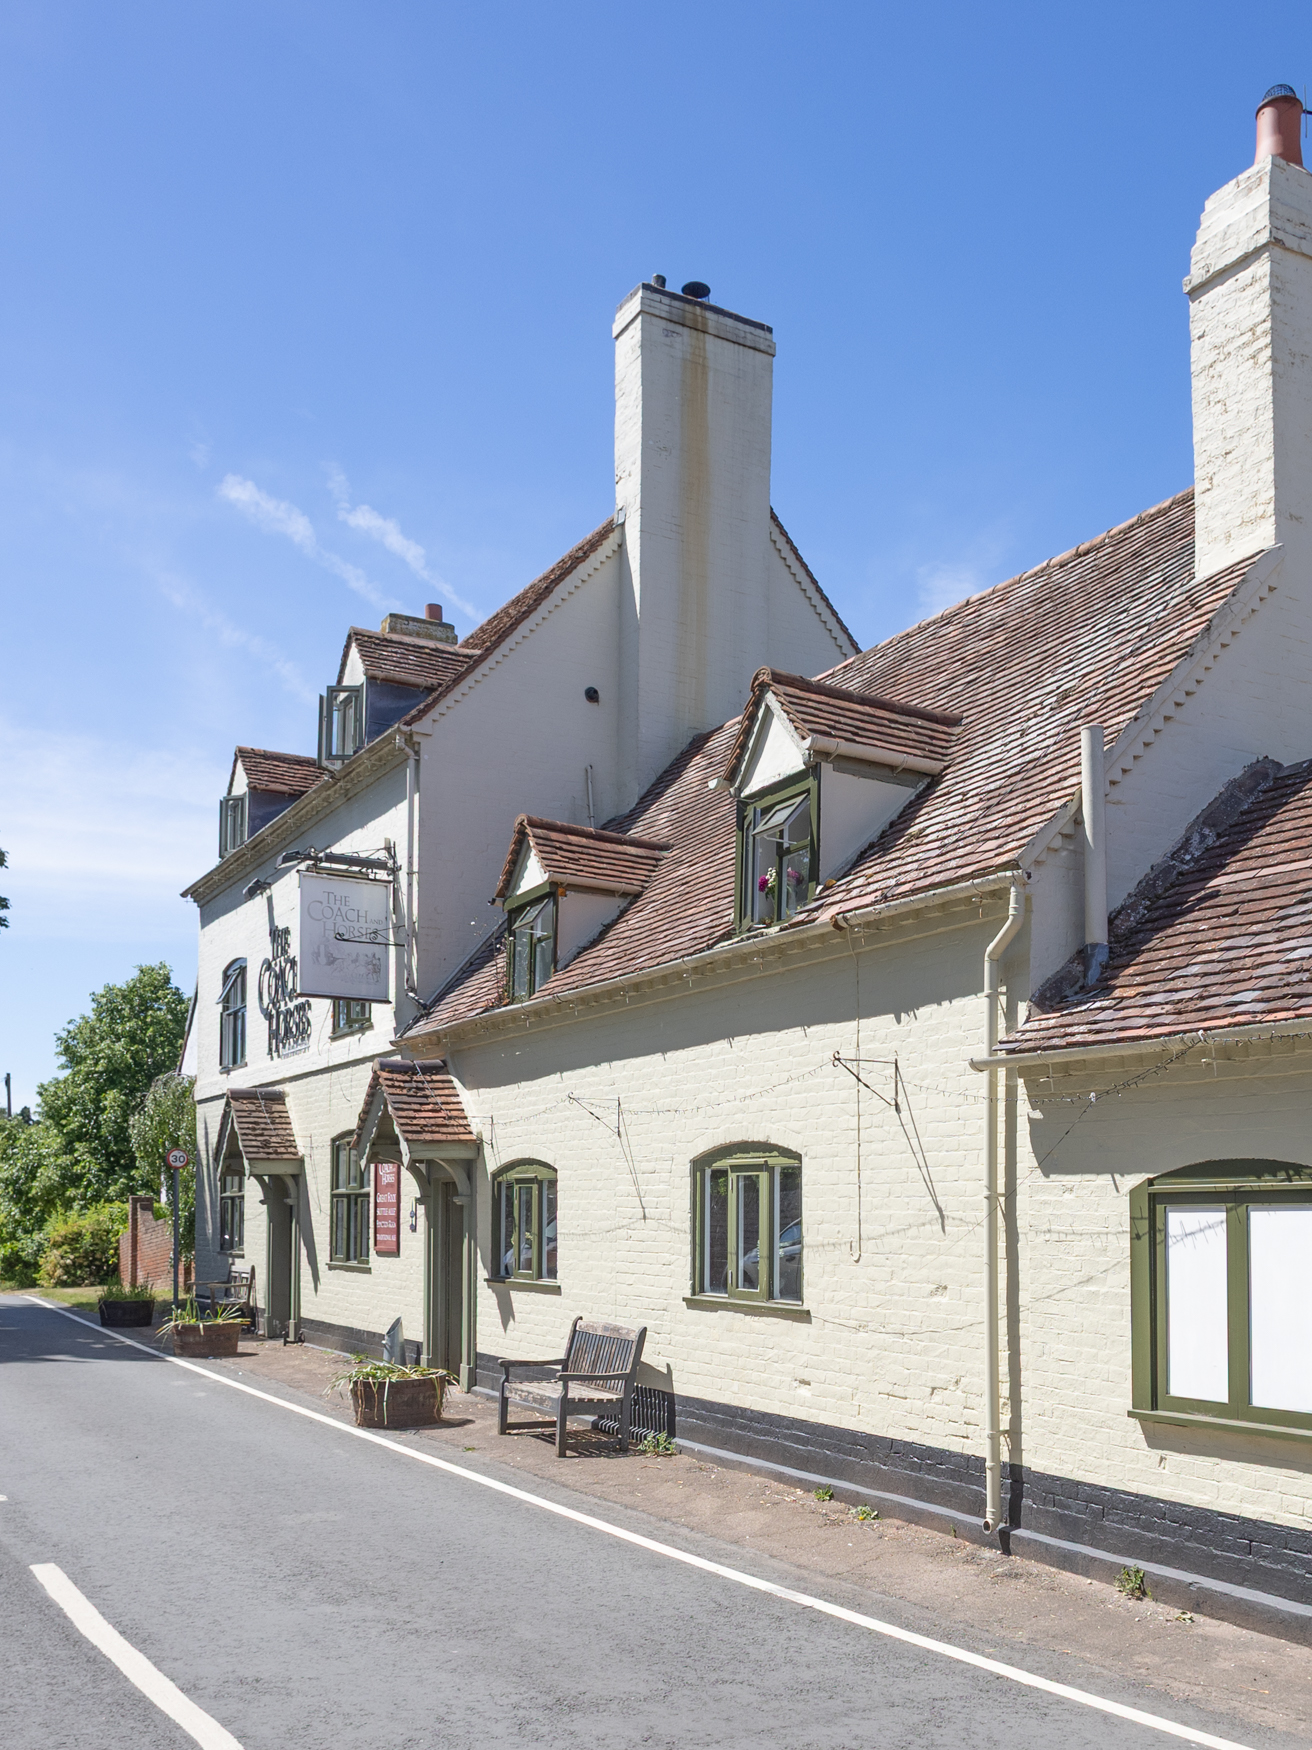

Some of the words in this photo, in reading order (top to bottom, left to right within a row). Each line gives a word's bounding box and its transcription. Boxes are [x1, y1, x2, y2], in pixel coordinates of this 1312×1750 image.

[322, 890, 350, 907] THE
[307, 900, 368, 924] COACH
[369, 918, 383, 926] AND
[269, 924, 291, 961] THE
[267, 1000, 311, 1058] HORSES
[171, 1154, 185, 1163] 30
